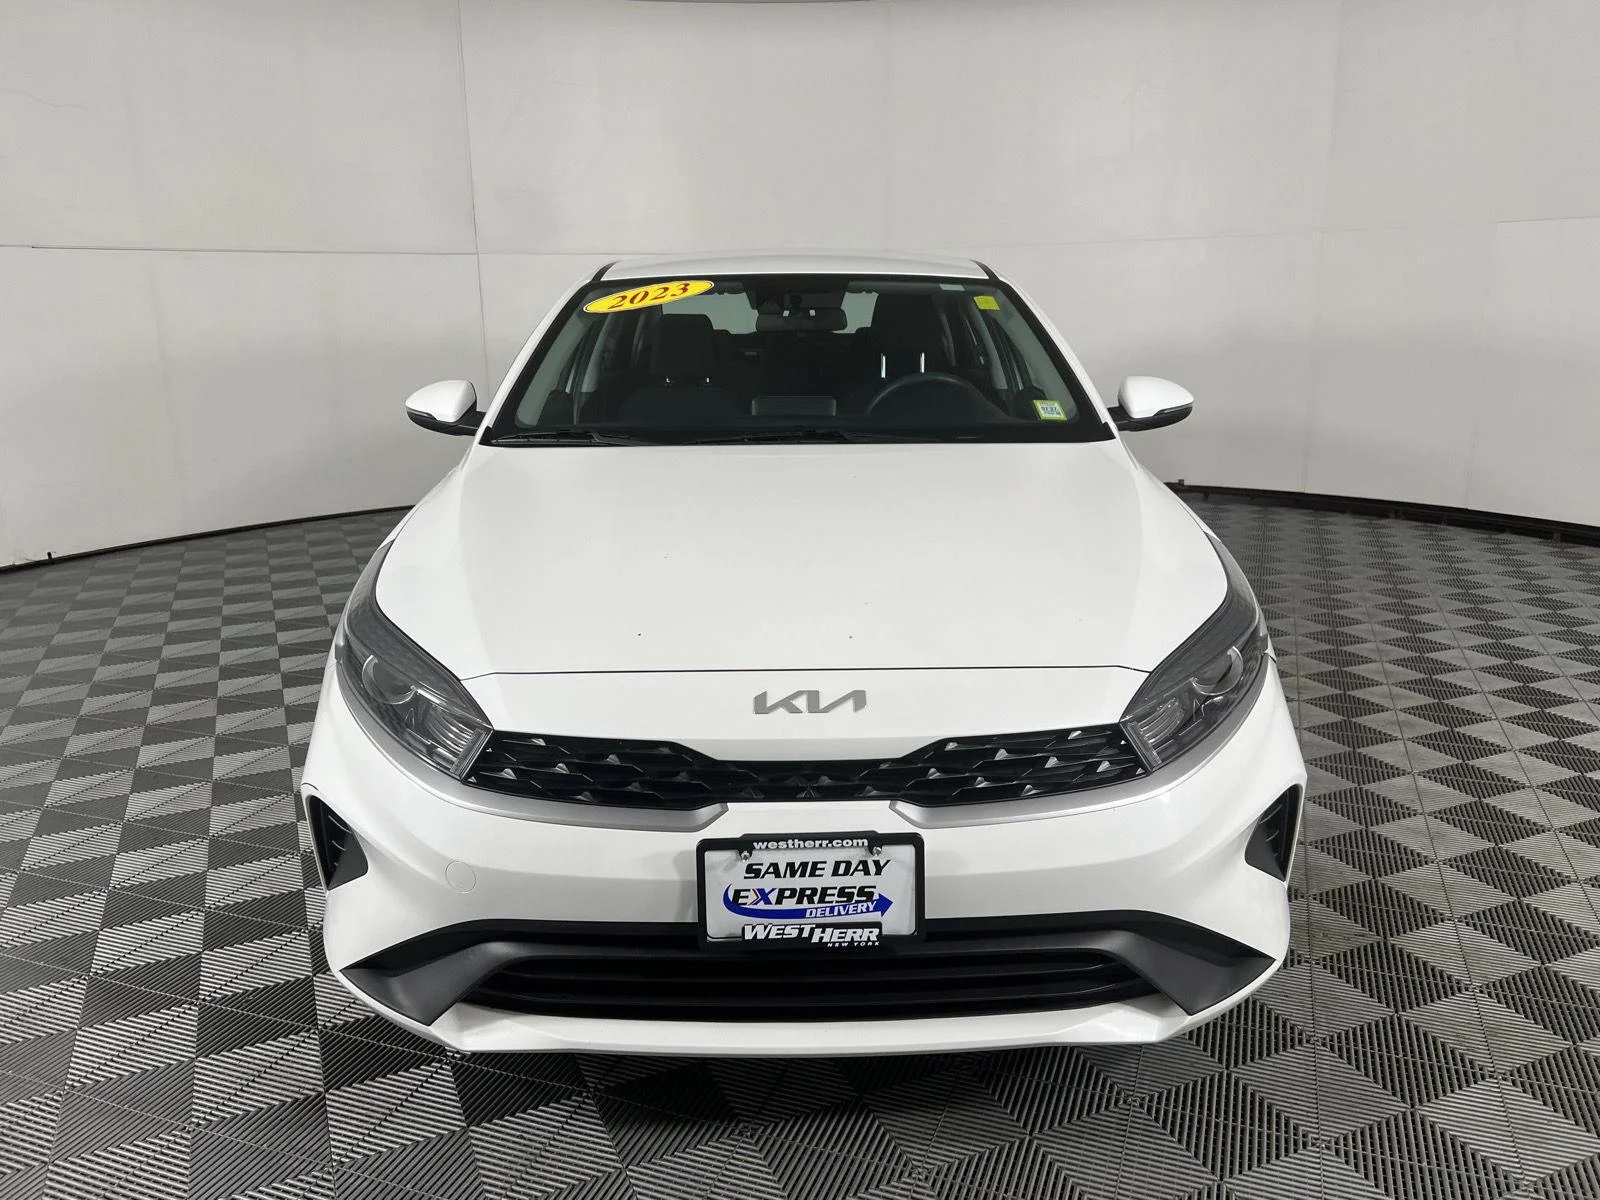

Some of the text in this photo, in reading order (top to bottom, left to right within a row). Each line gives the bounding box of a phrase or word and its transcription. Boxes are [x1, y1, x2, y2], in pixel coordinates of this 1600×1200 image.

[607, 283, 690, 310] 2023
[753, 690, 867, 715] KIA
[752, 838, 869, 850] westherr.com
[743, 859, 891, 880] SAME DAY
[731, 885, 877, 906] EXPRESS
[805, 900, 877, 918] DELIVERY
